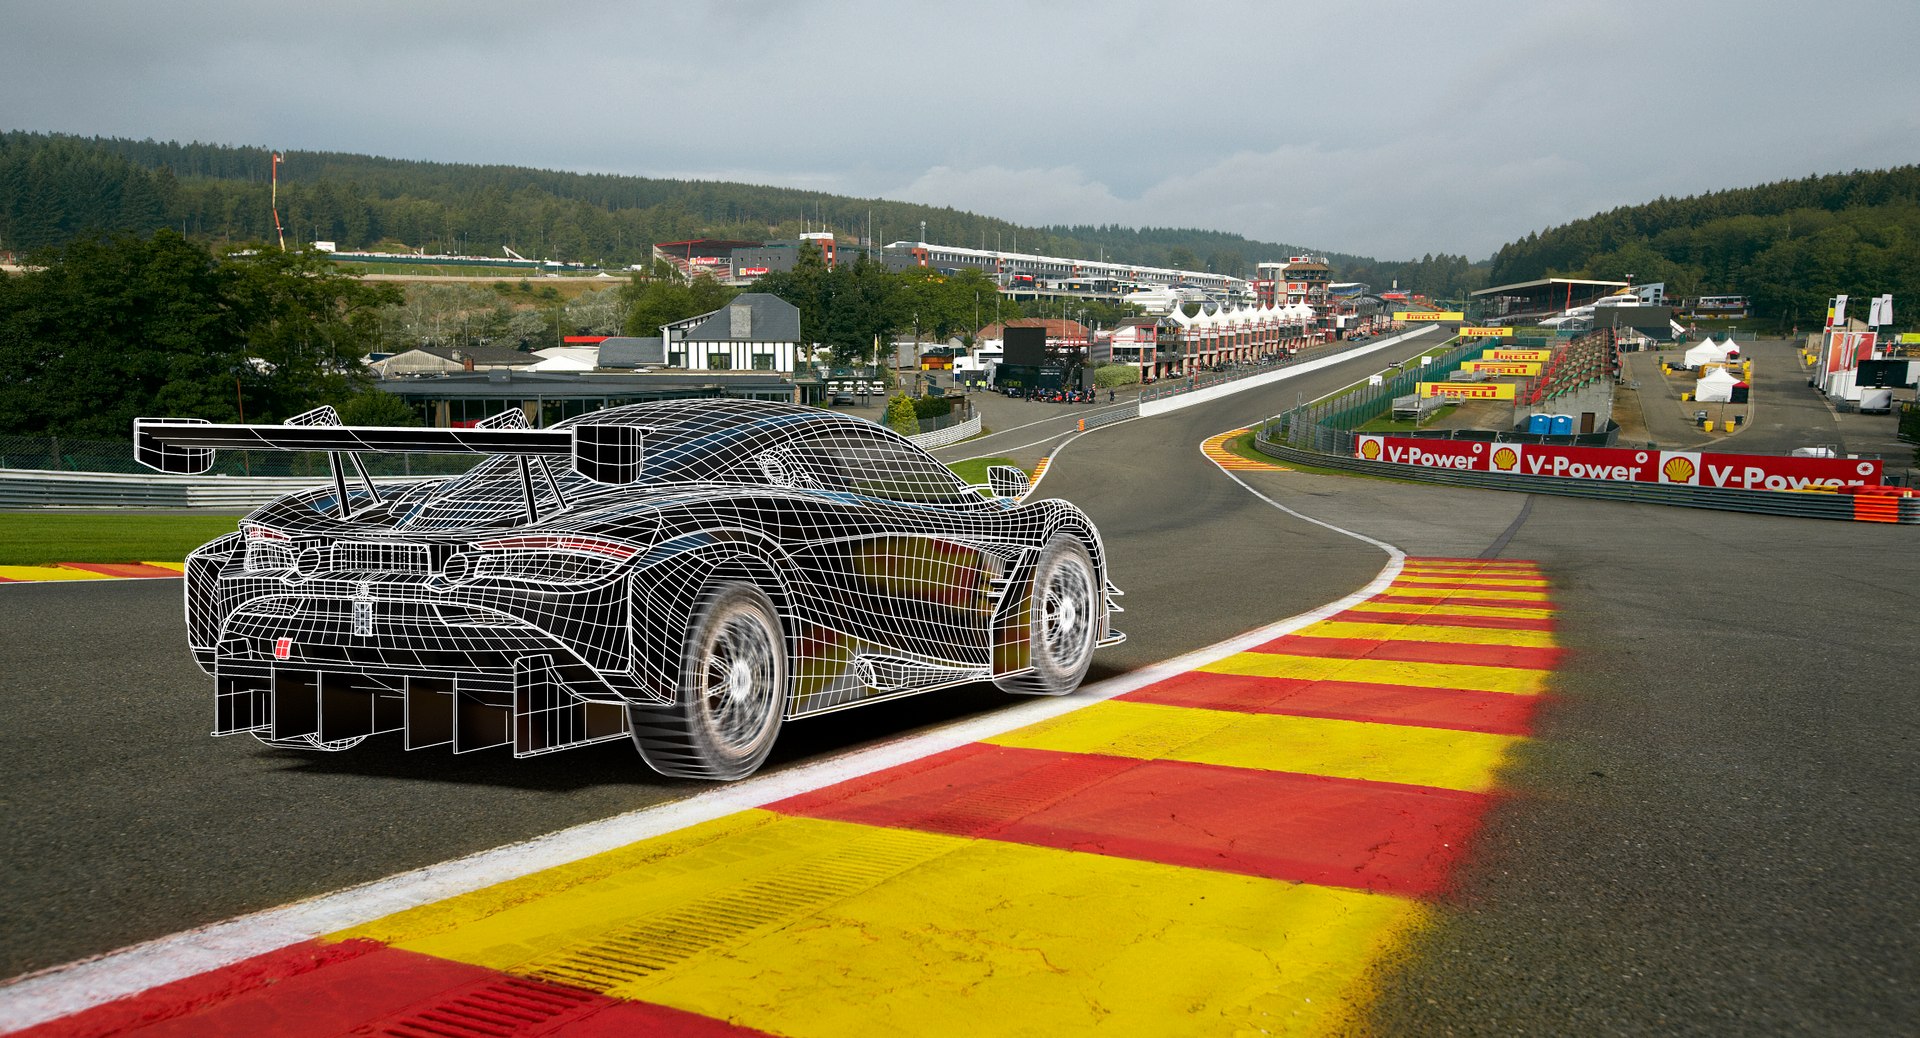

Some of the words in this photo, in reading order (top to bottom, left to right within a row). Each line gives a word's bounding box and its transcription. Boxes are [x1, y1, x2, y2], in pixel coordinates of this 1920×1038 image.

[1494, 352, 1539, 360] PIRELLI
[1387, 445, 1478, 470] V-Power
[1527, 454, 1642, 482] V-Power
